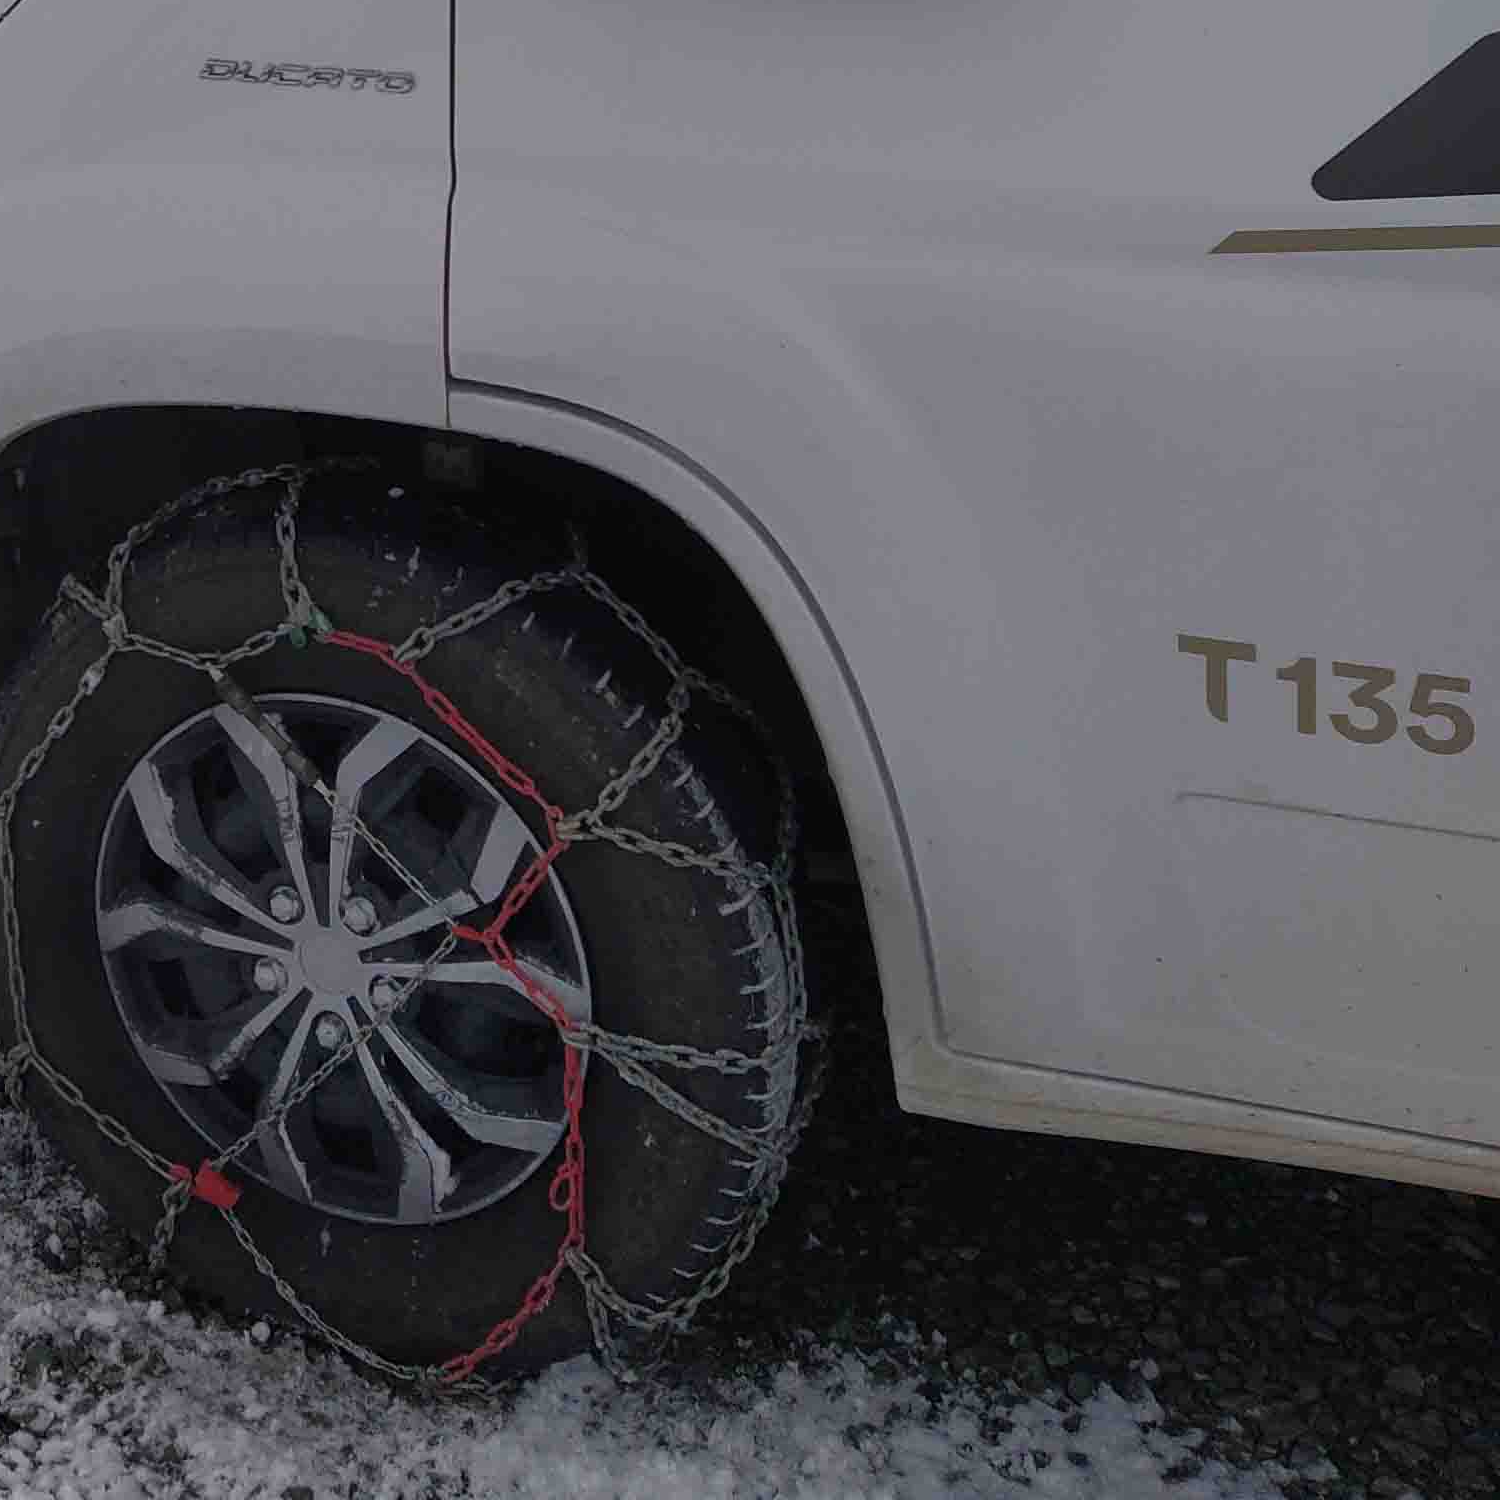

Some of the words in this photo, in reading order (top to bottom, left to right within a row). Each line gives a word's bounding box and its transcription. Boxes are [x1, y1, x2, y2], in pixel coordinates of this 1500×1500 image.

[200, 58, 415, 94] DUCATO
[1178, 633, 1256, 722] T
[1276, 657, 1475, 755] 135
